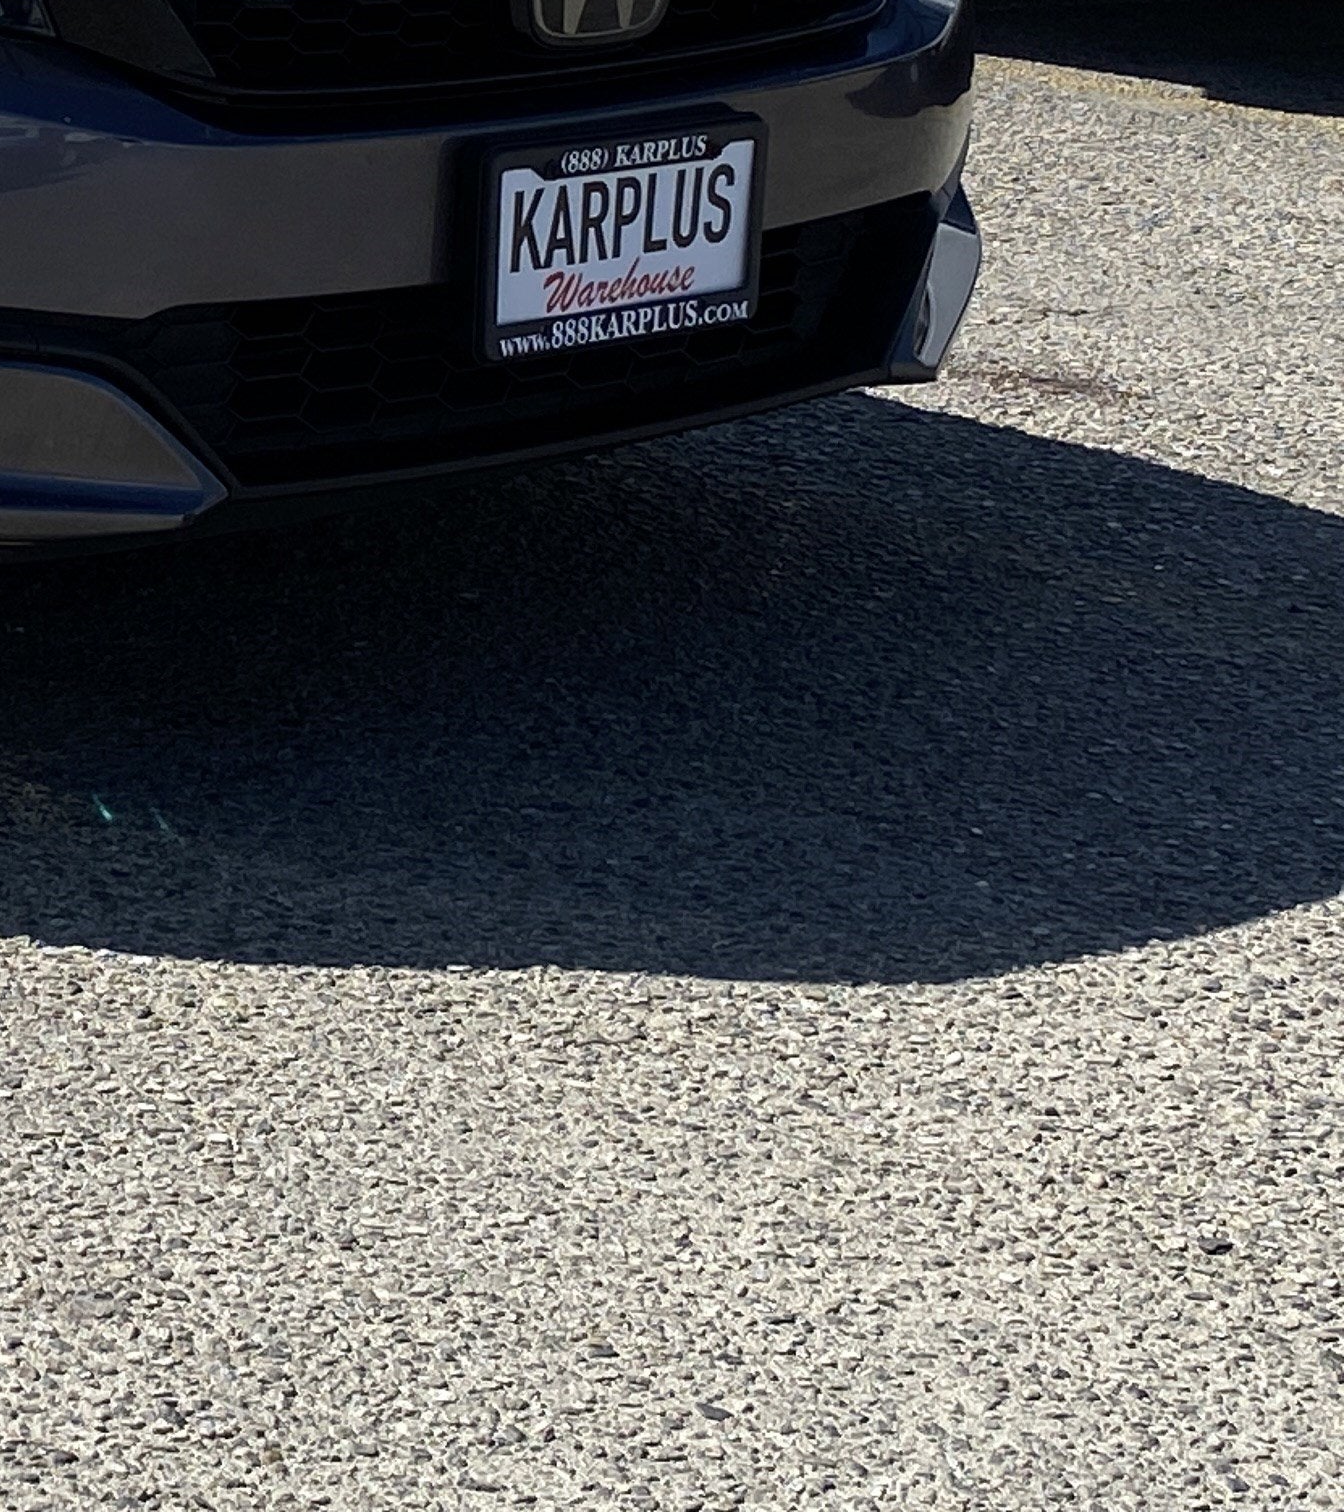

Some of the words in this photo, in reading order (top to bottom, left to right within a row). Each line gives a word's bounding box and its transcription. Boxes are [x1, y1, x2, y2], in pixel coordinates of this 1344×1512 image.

[561, 148, 608, 174] (888)
[614, 135, 708, 167] KARPLUS
[510, 164, 735, 274] KARPLUS
[543, 257, 696, 314] Warehouse
